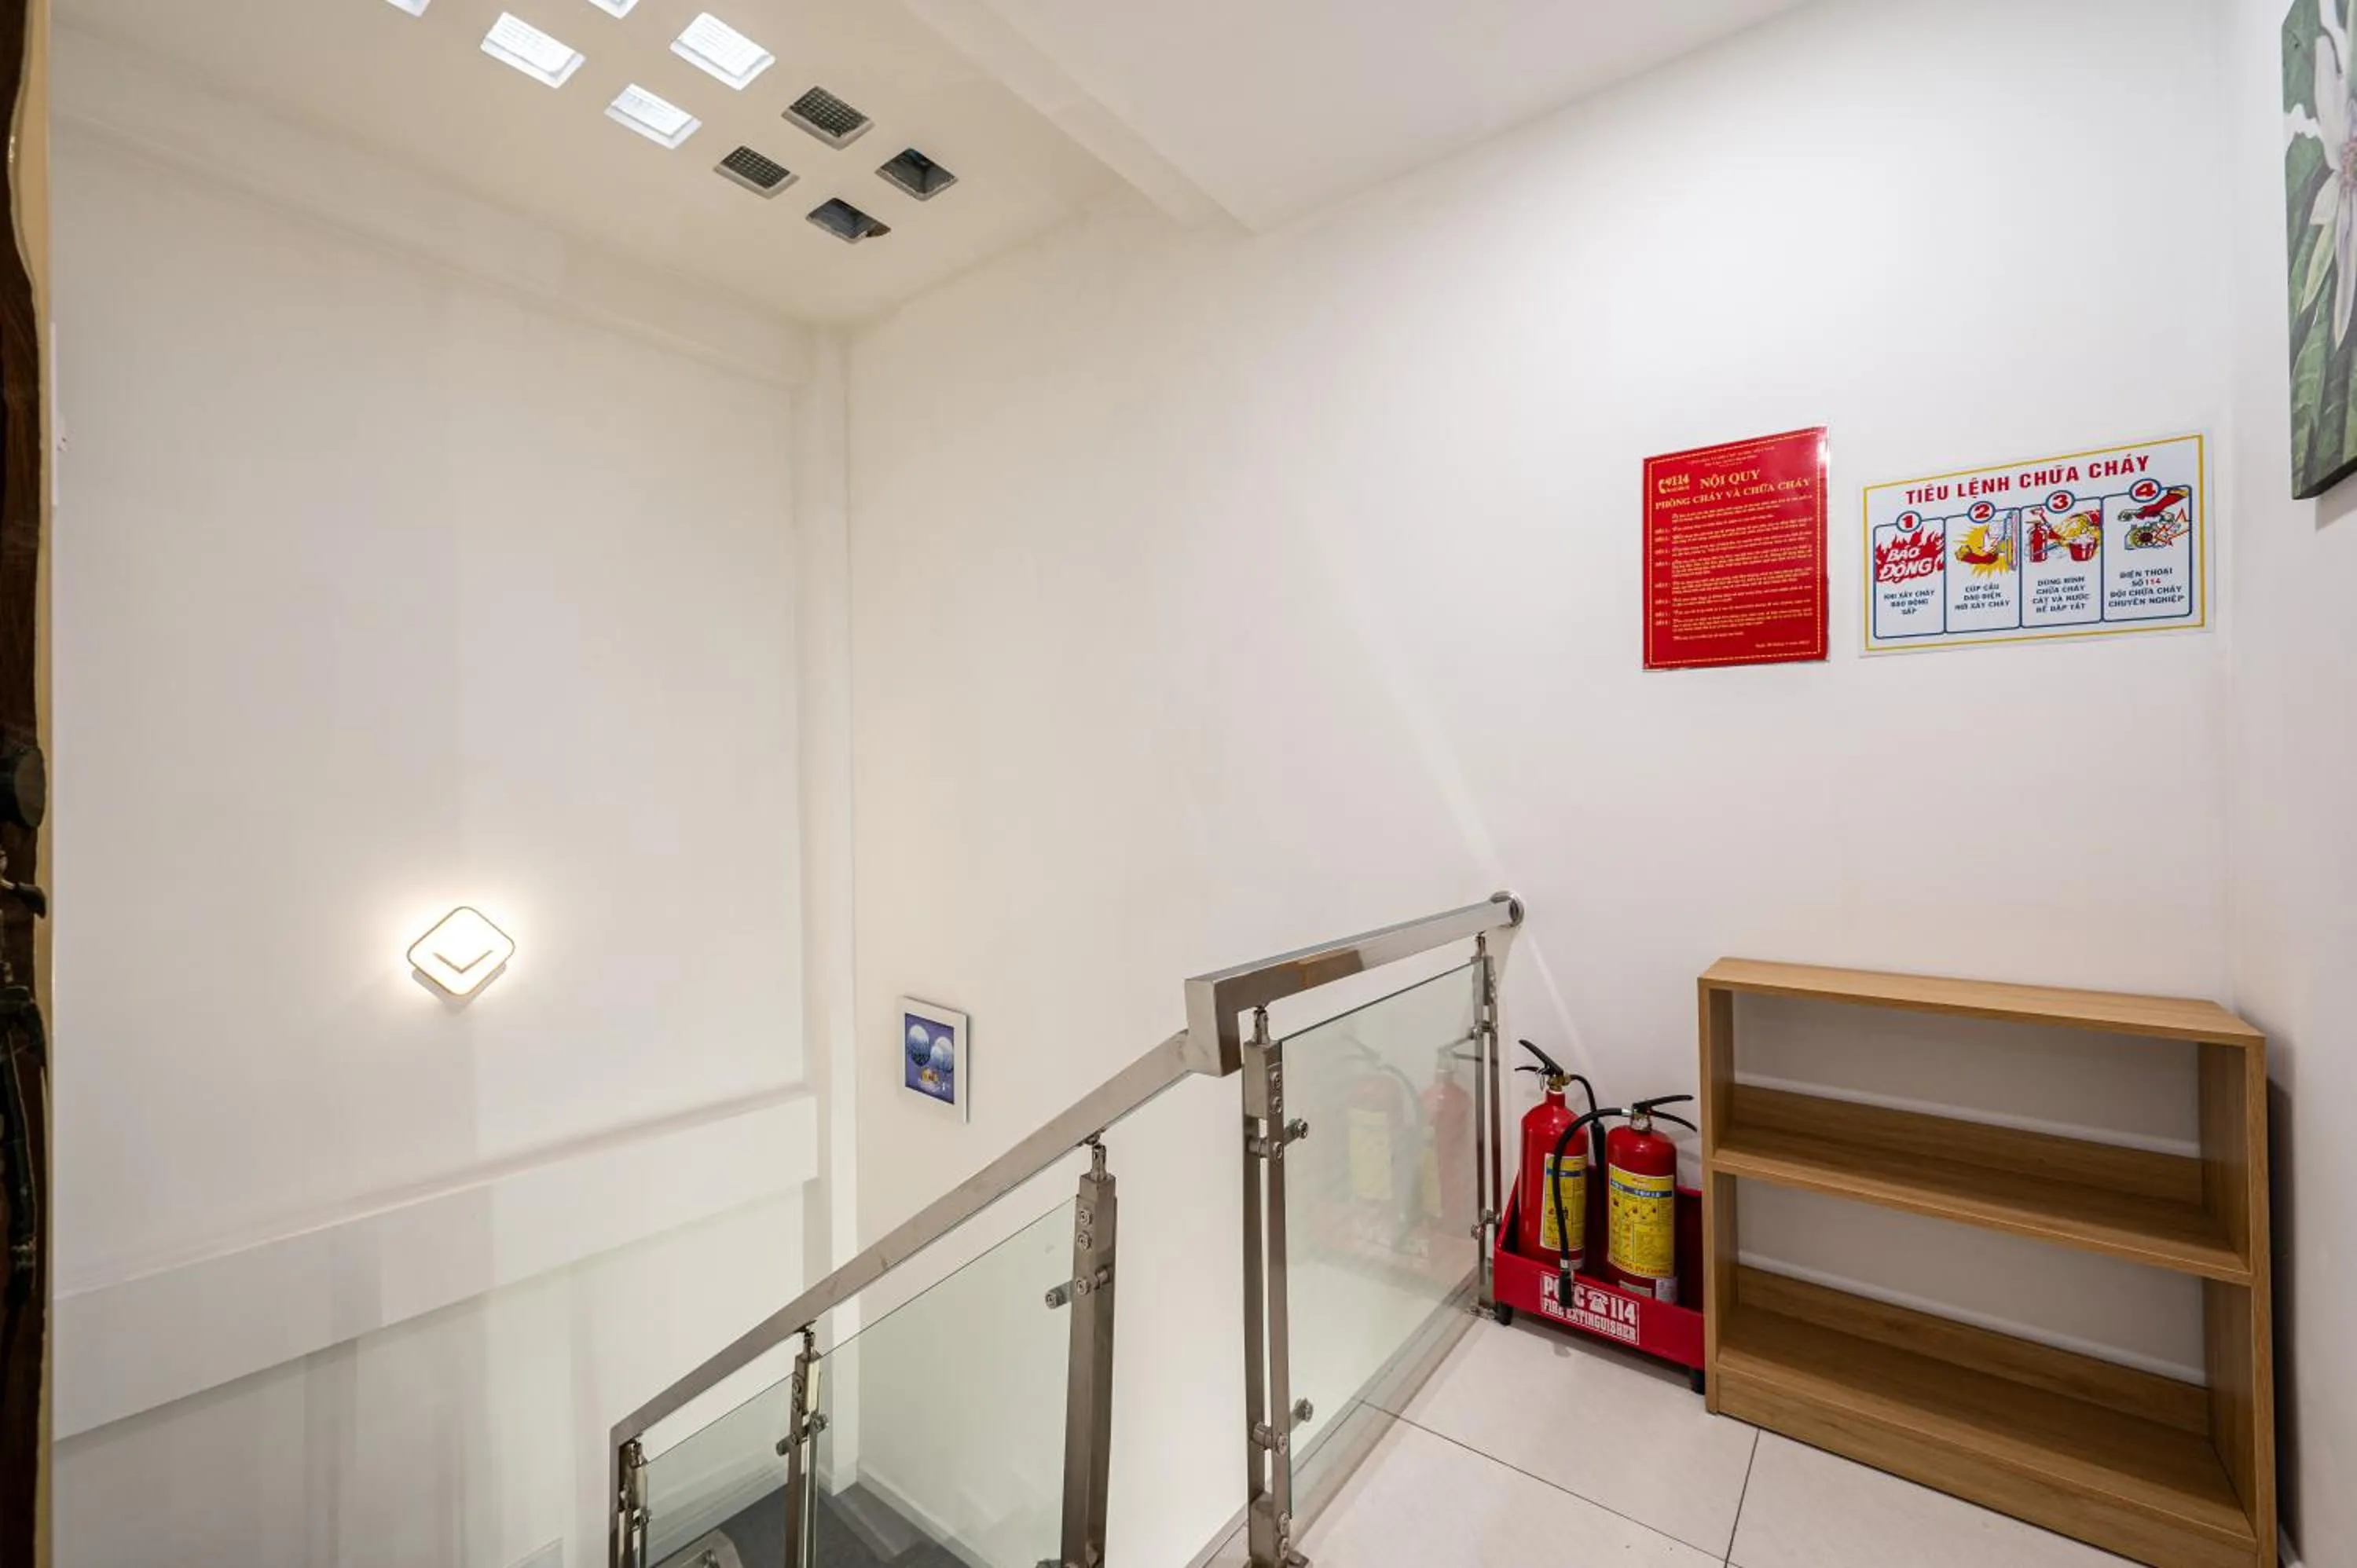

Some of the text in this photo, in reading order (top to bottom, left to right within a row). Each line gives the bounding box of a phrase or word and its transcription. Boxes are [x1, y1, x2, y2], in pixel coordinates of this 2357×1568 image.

[1700, 474, 1725, 489] NỘI
[1728, 469, 1760, 485] QUY
[1906, 453, 2149, 504] TIÊU LỆNH CHỮA CHÁY
[1655, 494, 1691, 510] PHÒNG
[1693, 490, 1723, 504] CHÁY
[1726, 486, 1741, 498] VÀ
[1743, 482, 1775, 496] CHỮA
[1777, 478, 1811, 491] CHÁY
[2135, 482, 2157, 497] 4
[2052, 493, 2069, 510] 3
[1974, 505, 1990, 519] 2
[1903, 515, 1913, 529] 1
[1886, 545, 1921, 562] BÁO
[1879, 558, 1933, 581] ĐỘNG
[1610, 1297, 1636, 1325] 114
